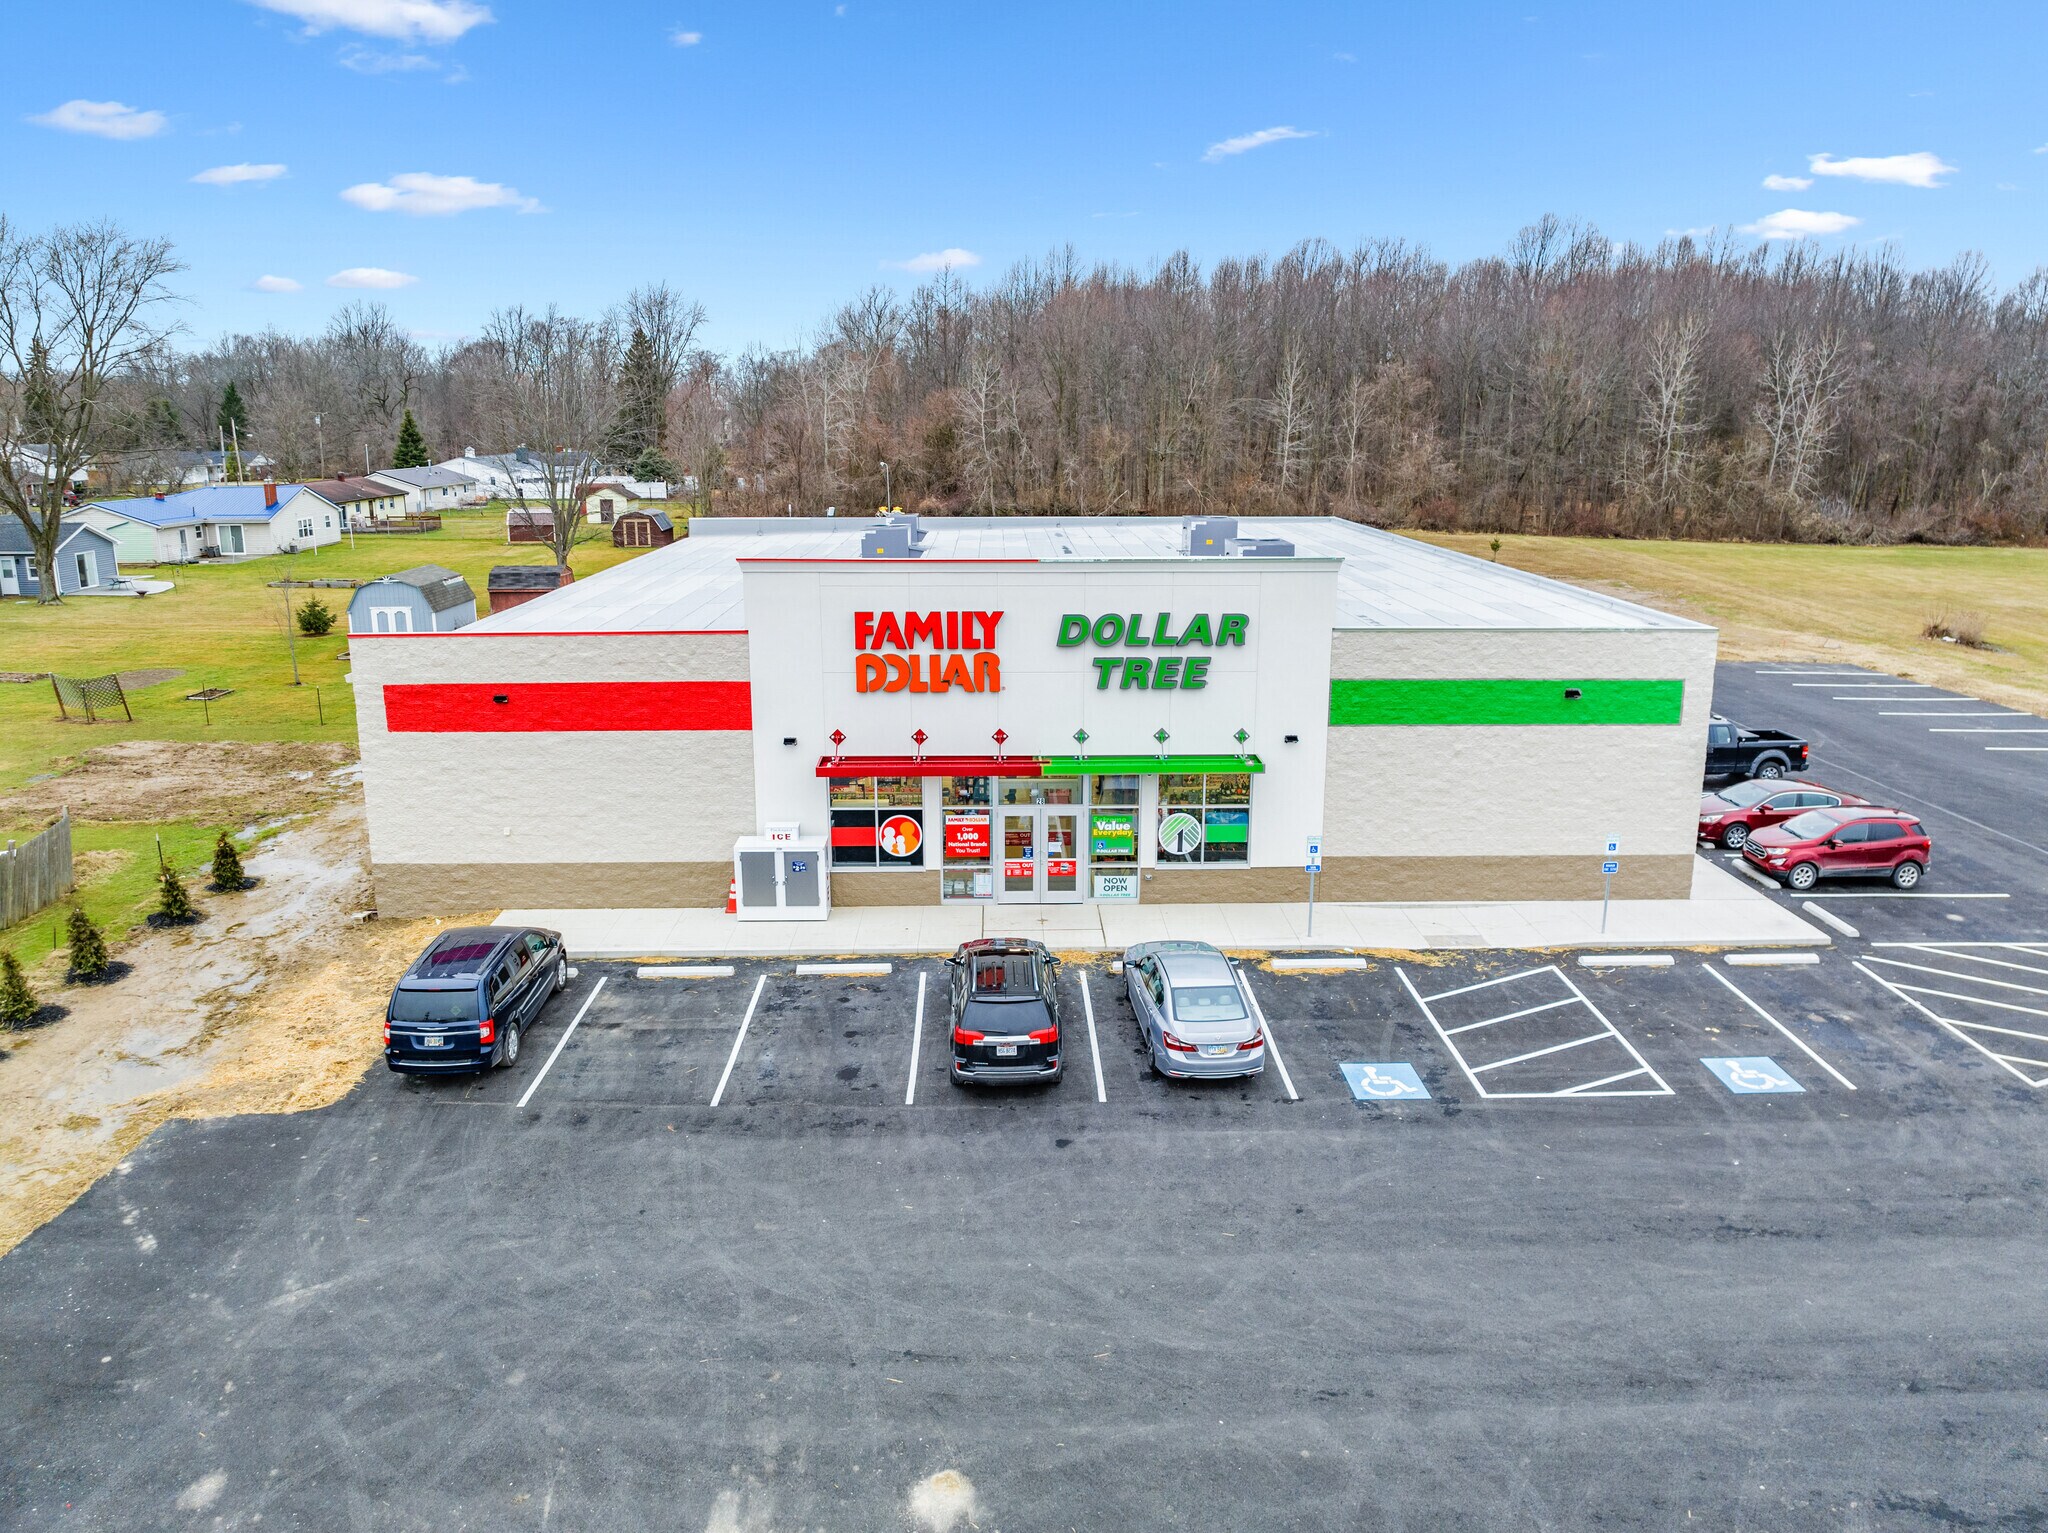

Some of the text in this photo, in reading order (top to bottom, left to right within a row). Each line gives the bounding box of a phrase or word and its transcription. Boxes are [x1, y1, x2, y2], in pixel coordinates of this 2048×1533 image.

[854, 611, 1004, 650] FAMILY
[1056, 612, 1250, 648] DOLLAR
[855, 652, 1001, 693] DOLLAR
[1092, 656, 1212, 690] TREE
[957, 832, 979, 841] 1,000
[1093, 829, 1133, 837] Everyday
[1096, 820, 1131, 831] Value
